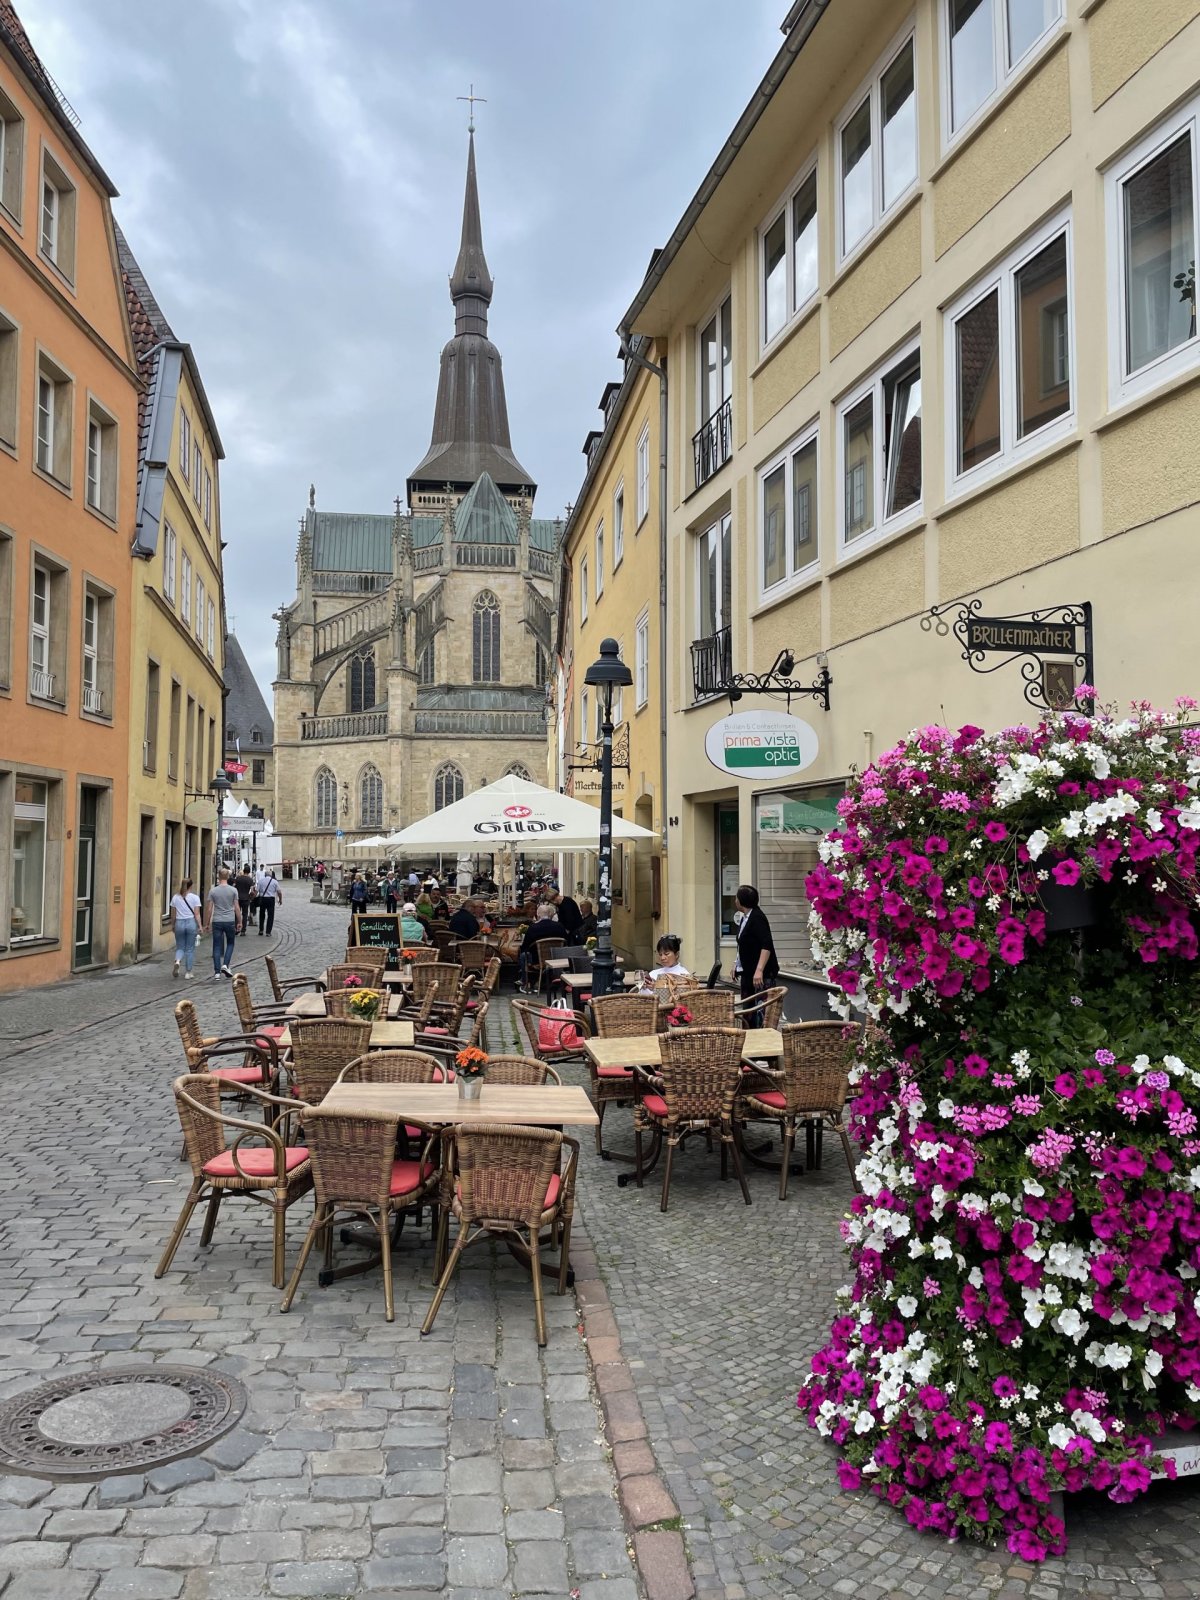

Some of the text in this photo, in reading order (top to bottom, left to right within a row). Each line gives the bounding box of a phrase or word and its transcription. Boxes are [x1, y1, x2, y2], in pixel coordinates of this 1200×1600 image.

[726, 732, 797, 750] prima vista
[764, 747, 799, 765] optic
